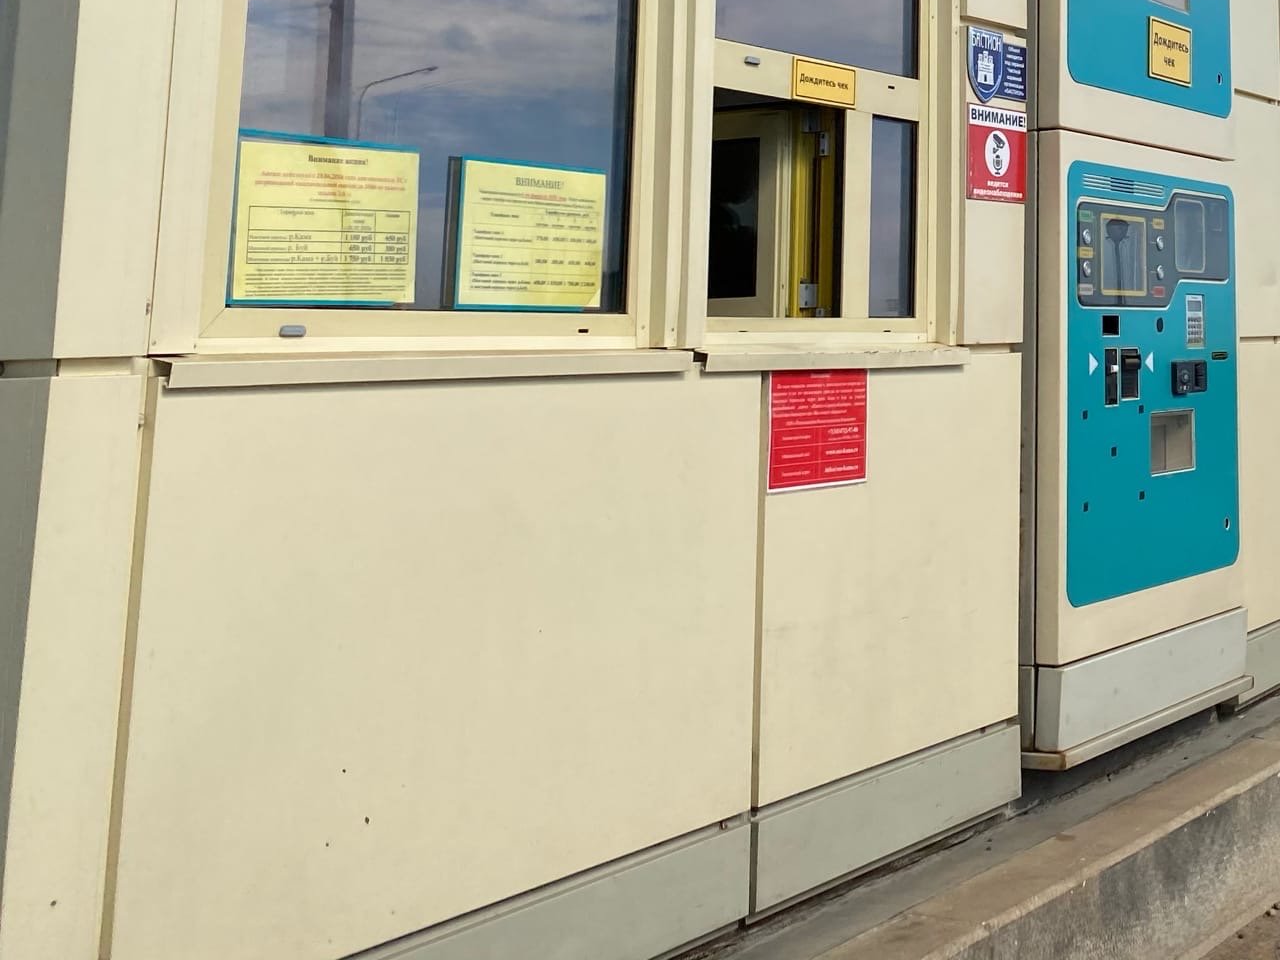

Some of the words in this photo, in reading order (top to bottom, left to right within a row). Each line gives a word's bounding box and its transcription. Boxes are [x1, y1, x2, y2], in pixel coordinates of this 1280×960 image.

[971, 31, 1002, 52] БАСТИОН
[1153, 32, 1189, 54] Дождитесь
[1163, 56, 1176, 68] чек
[799, 73, 836, 88] Дождитесь
[970, 107, 1027, 128] ВНИМАНИЕ!
